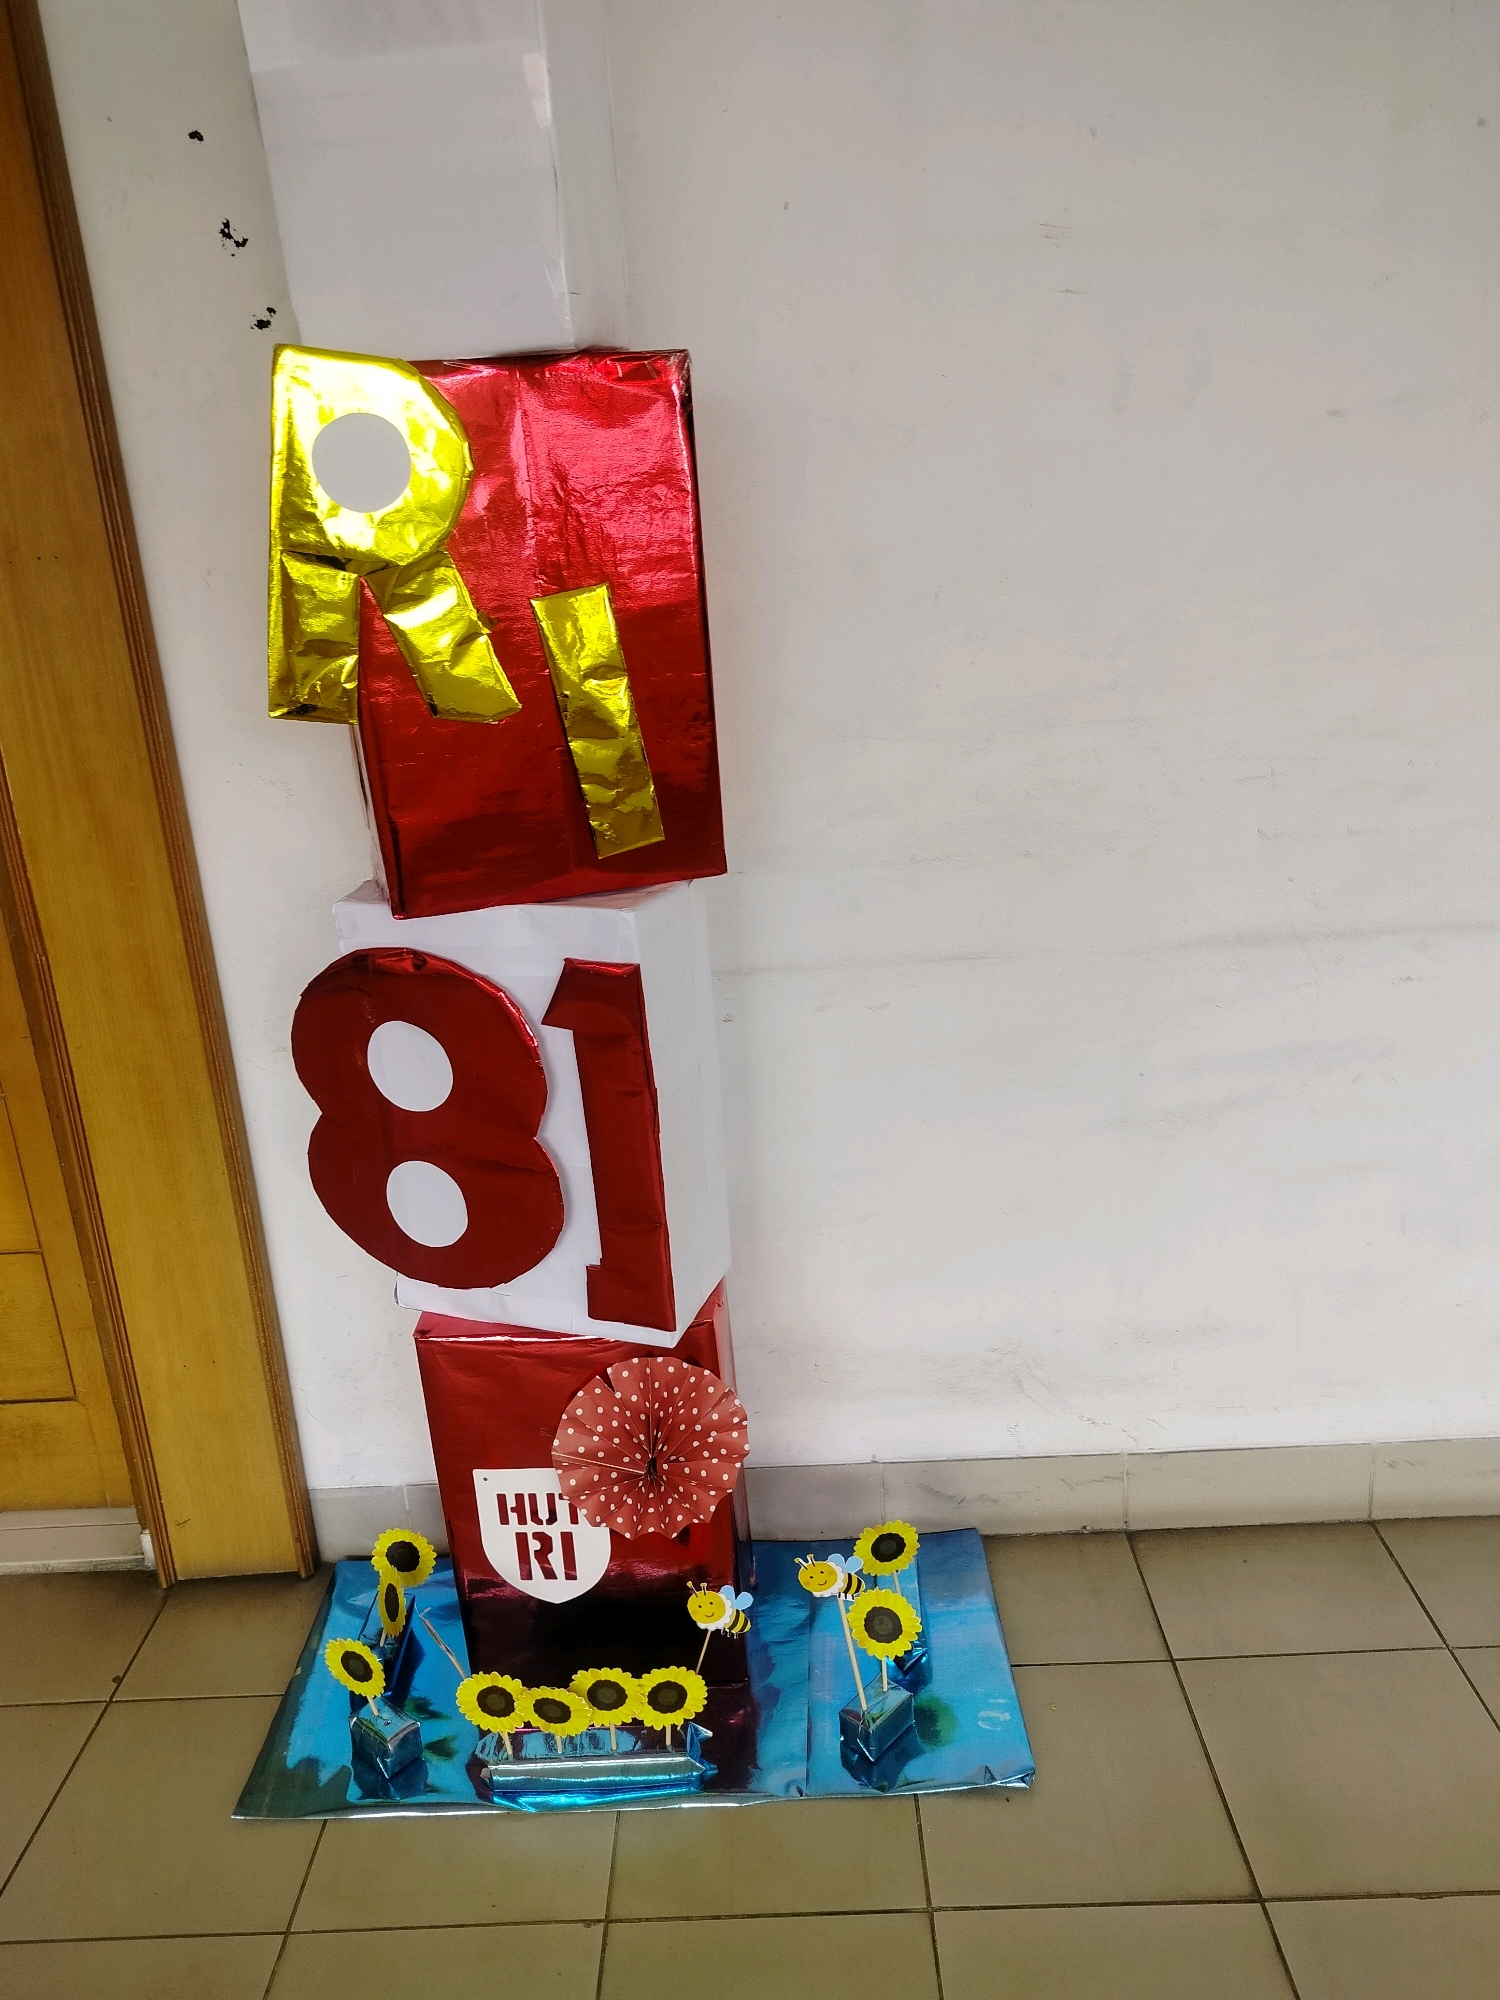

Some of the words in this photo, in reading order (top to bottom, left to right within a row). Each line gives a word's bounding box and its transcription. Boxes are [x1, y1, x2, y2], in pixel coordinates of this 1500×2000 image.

[291, 947, 677, 1332] 81
[496, 1493, 580, 1526] HUT
[514, 1531, 579, 1581] RI
